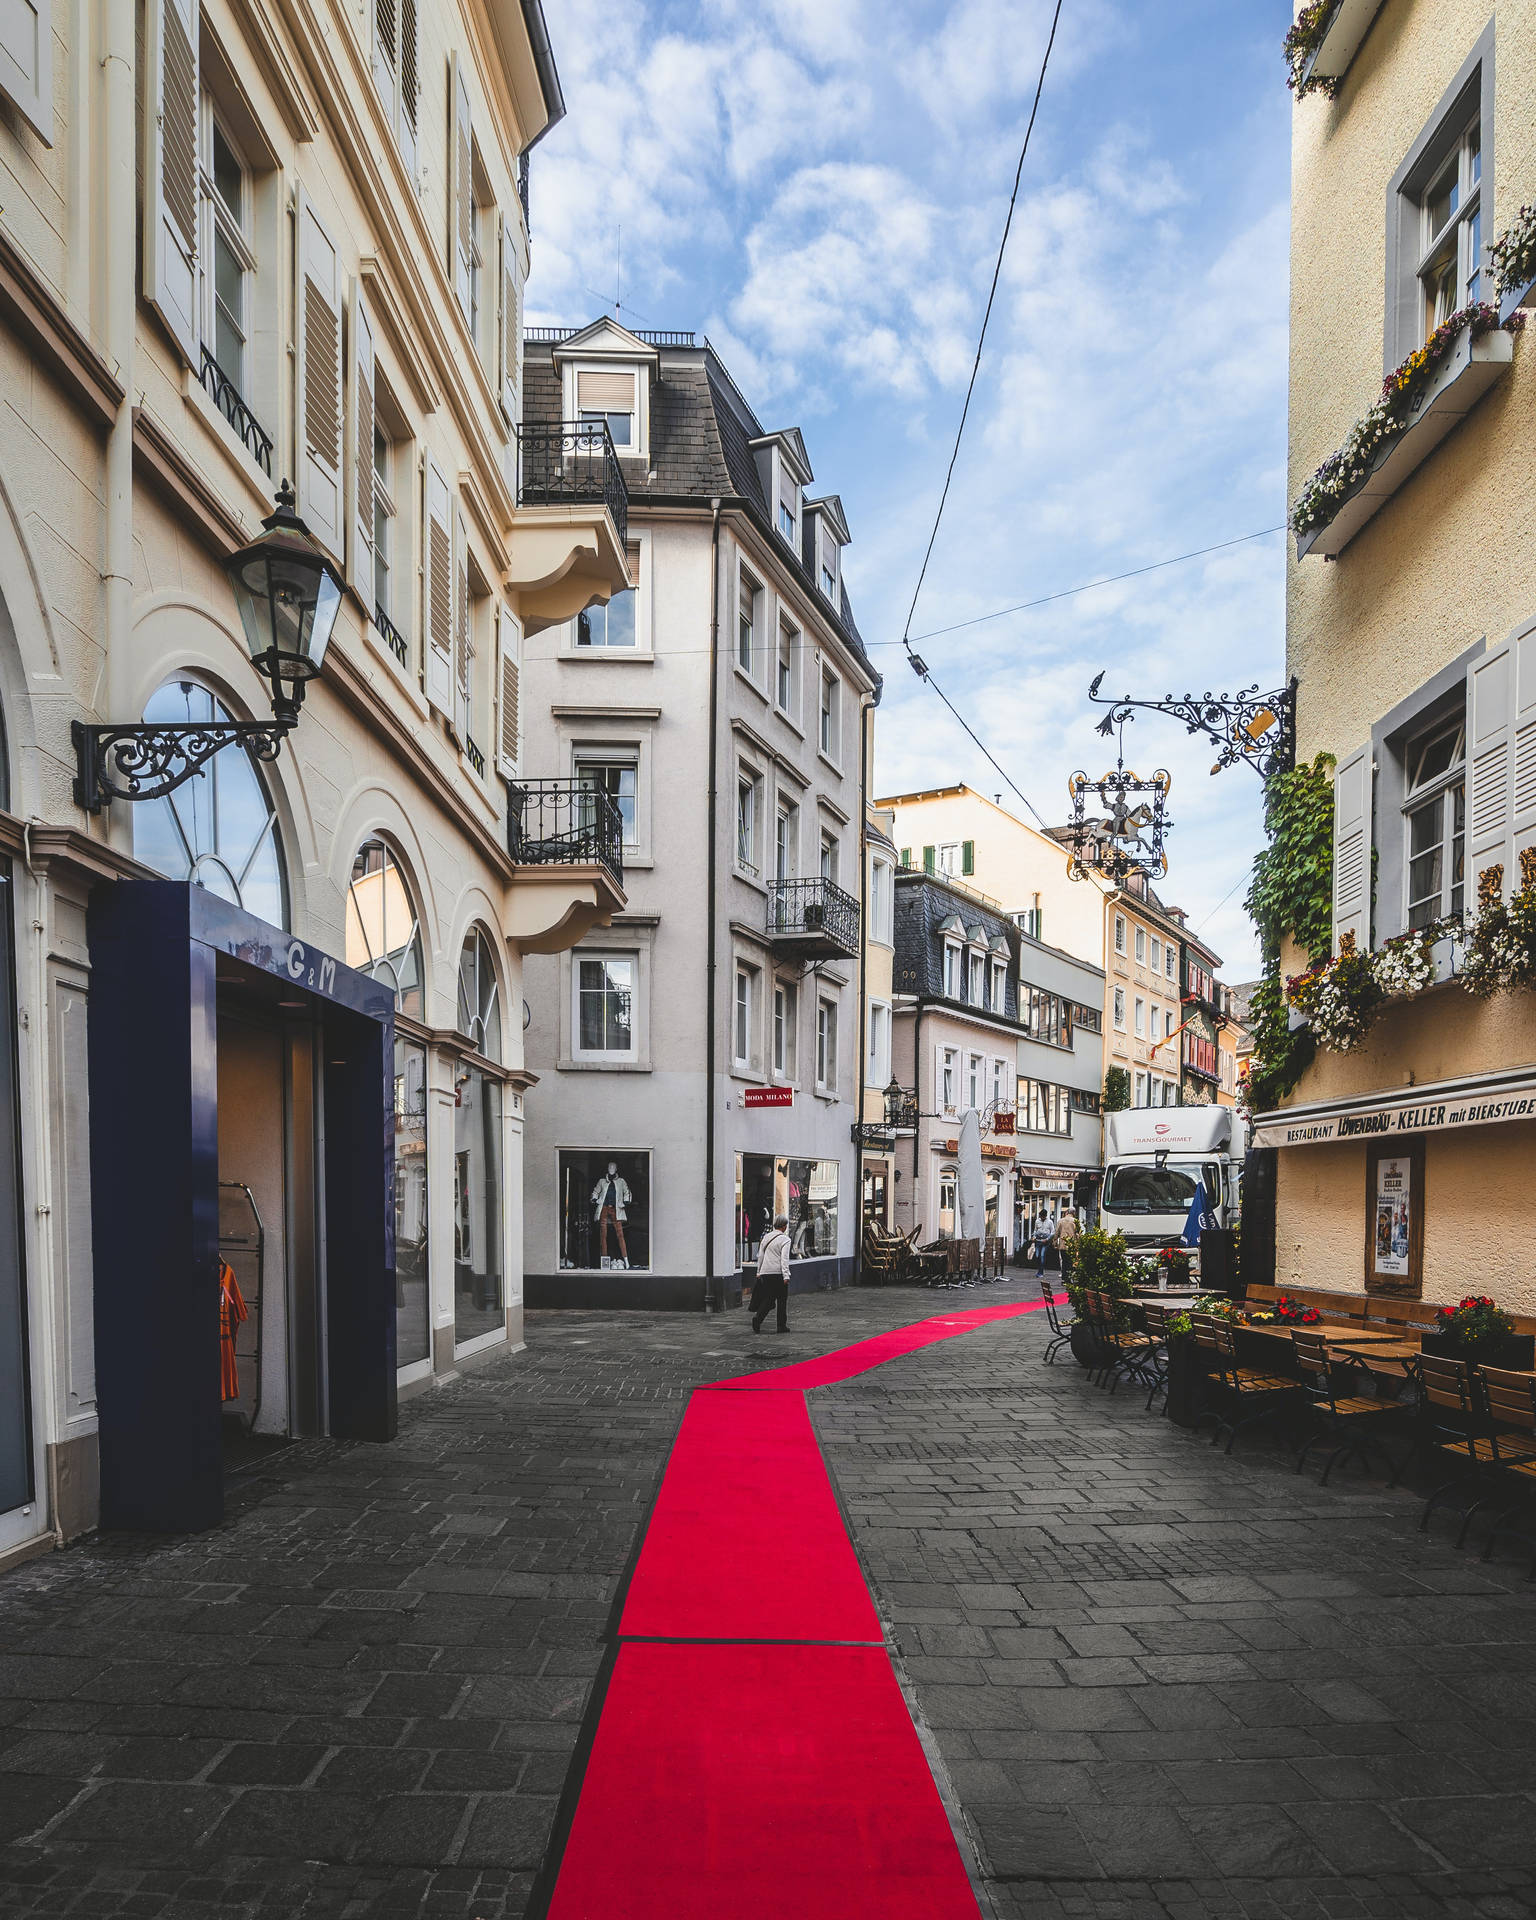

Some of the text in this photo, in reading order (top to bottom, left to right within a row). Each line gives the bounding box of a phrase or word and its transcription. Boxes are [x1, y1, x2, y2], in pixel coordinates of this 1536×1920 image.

[288, 942, 336, 994] G & M
[1133, 1136, 1193, 1144] TRANSGOURMET
[1287, 1125, 1333, 1142] RESTAURANT
[1448, 1108, 1467, 1123] mit
[1467, 1098, 1536, 1121] BIERSTUBE
